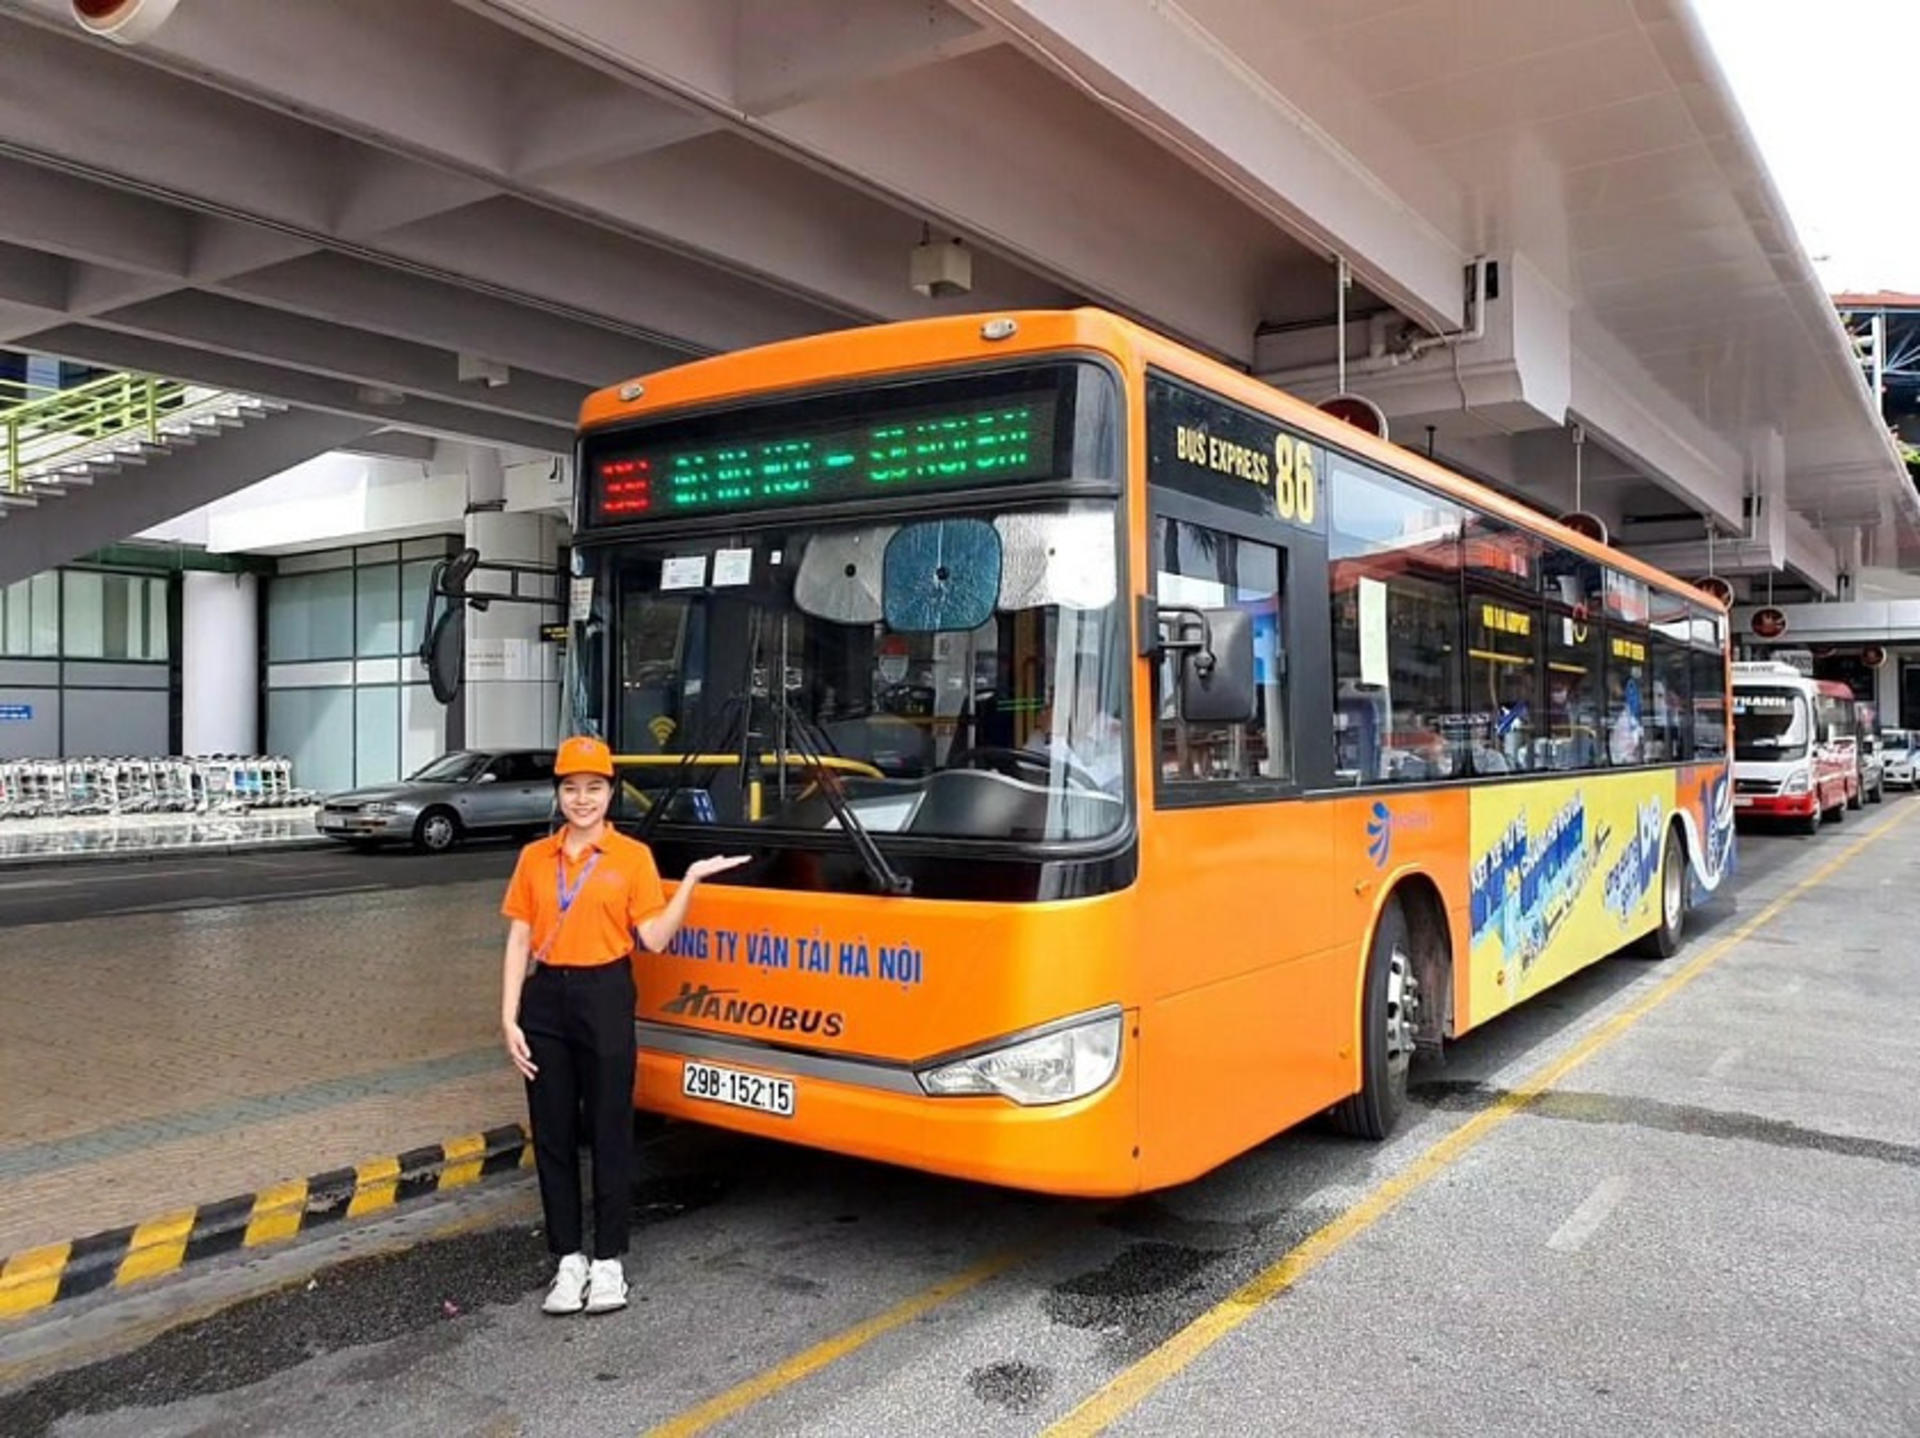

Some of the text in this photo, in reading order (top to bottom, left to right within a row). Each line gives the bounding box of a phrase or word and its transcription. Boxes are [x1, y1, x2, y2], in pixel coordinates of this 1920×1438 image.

[1177, 425, 1314, 525] BUS EXPRESS 86
[715, 930, 738, 963] TY
[746, 928, 789, 976] VẬN
[839, 935, 870, 978] HÀ
[878, 940, 921, 993] NỘI
[660, 982, 844, 1038] HANOIBUS
